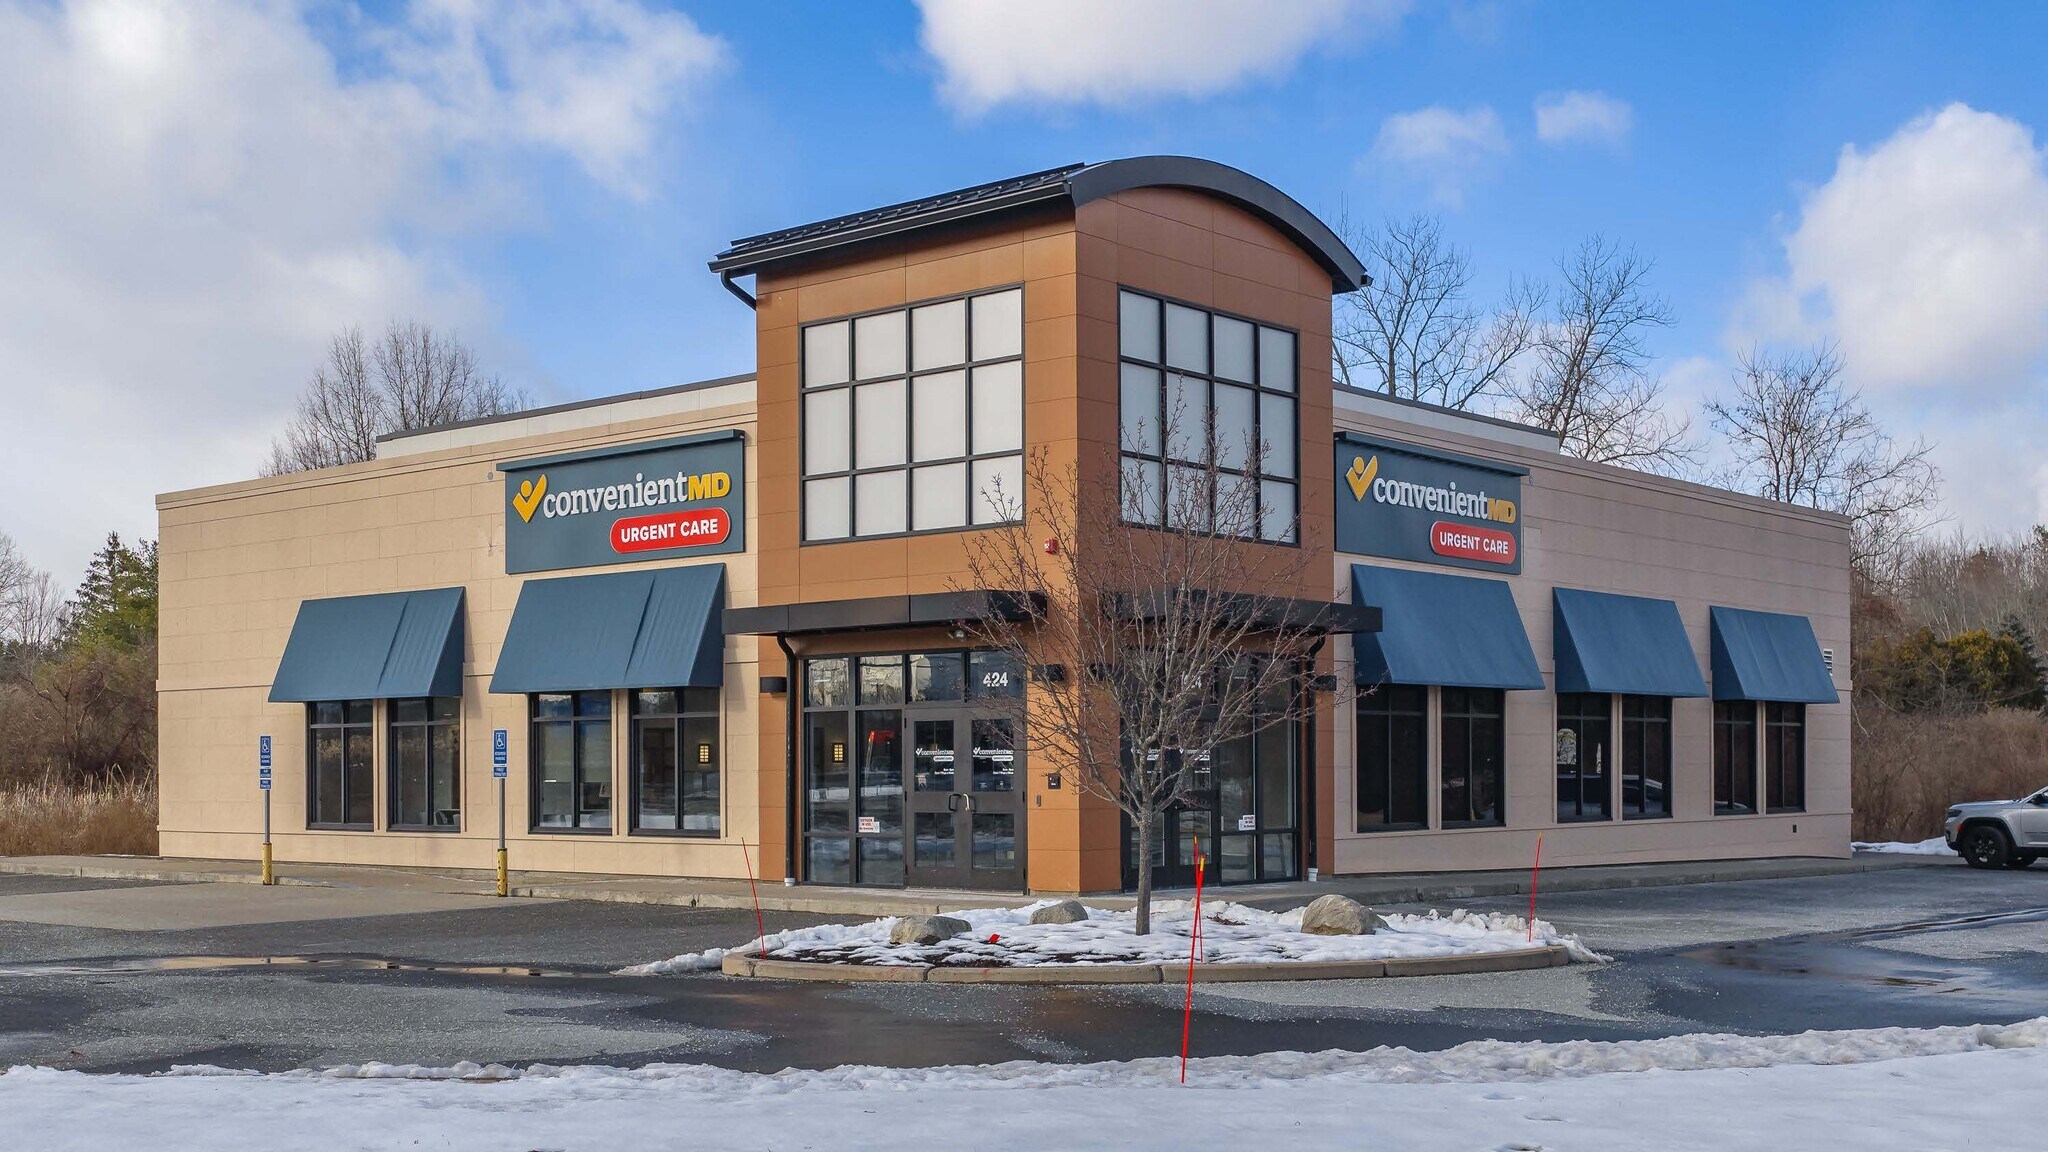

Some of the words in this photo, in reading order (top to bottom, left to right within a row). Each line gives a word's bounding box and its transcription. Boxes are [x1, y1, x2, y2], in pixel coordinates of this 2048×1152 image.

[542, 471, 731, 519] convenientMD
[1372, 477, 1517, 524] convenientMD
[620, 522, 676, 543] URGENT
[680, 518, 719, 537] CARE
[1439, 531, 1480, 550] URGENT
[1482, 538, 1509, 555] CARE
[982, 671, 1009, 688] 424
